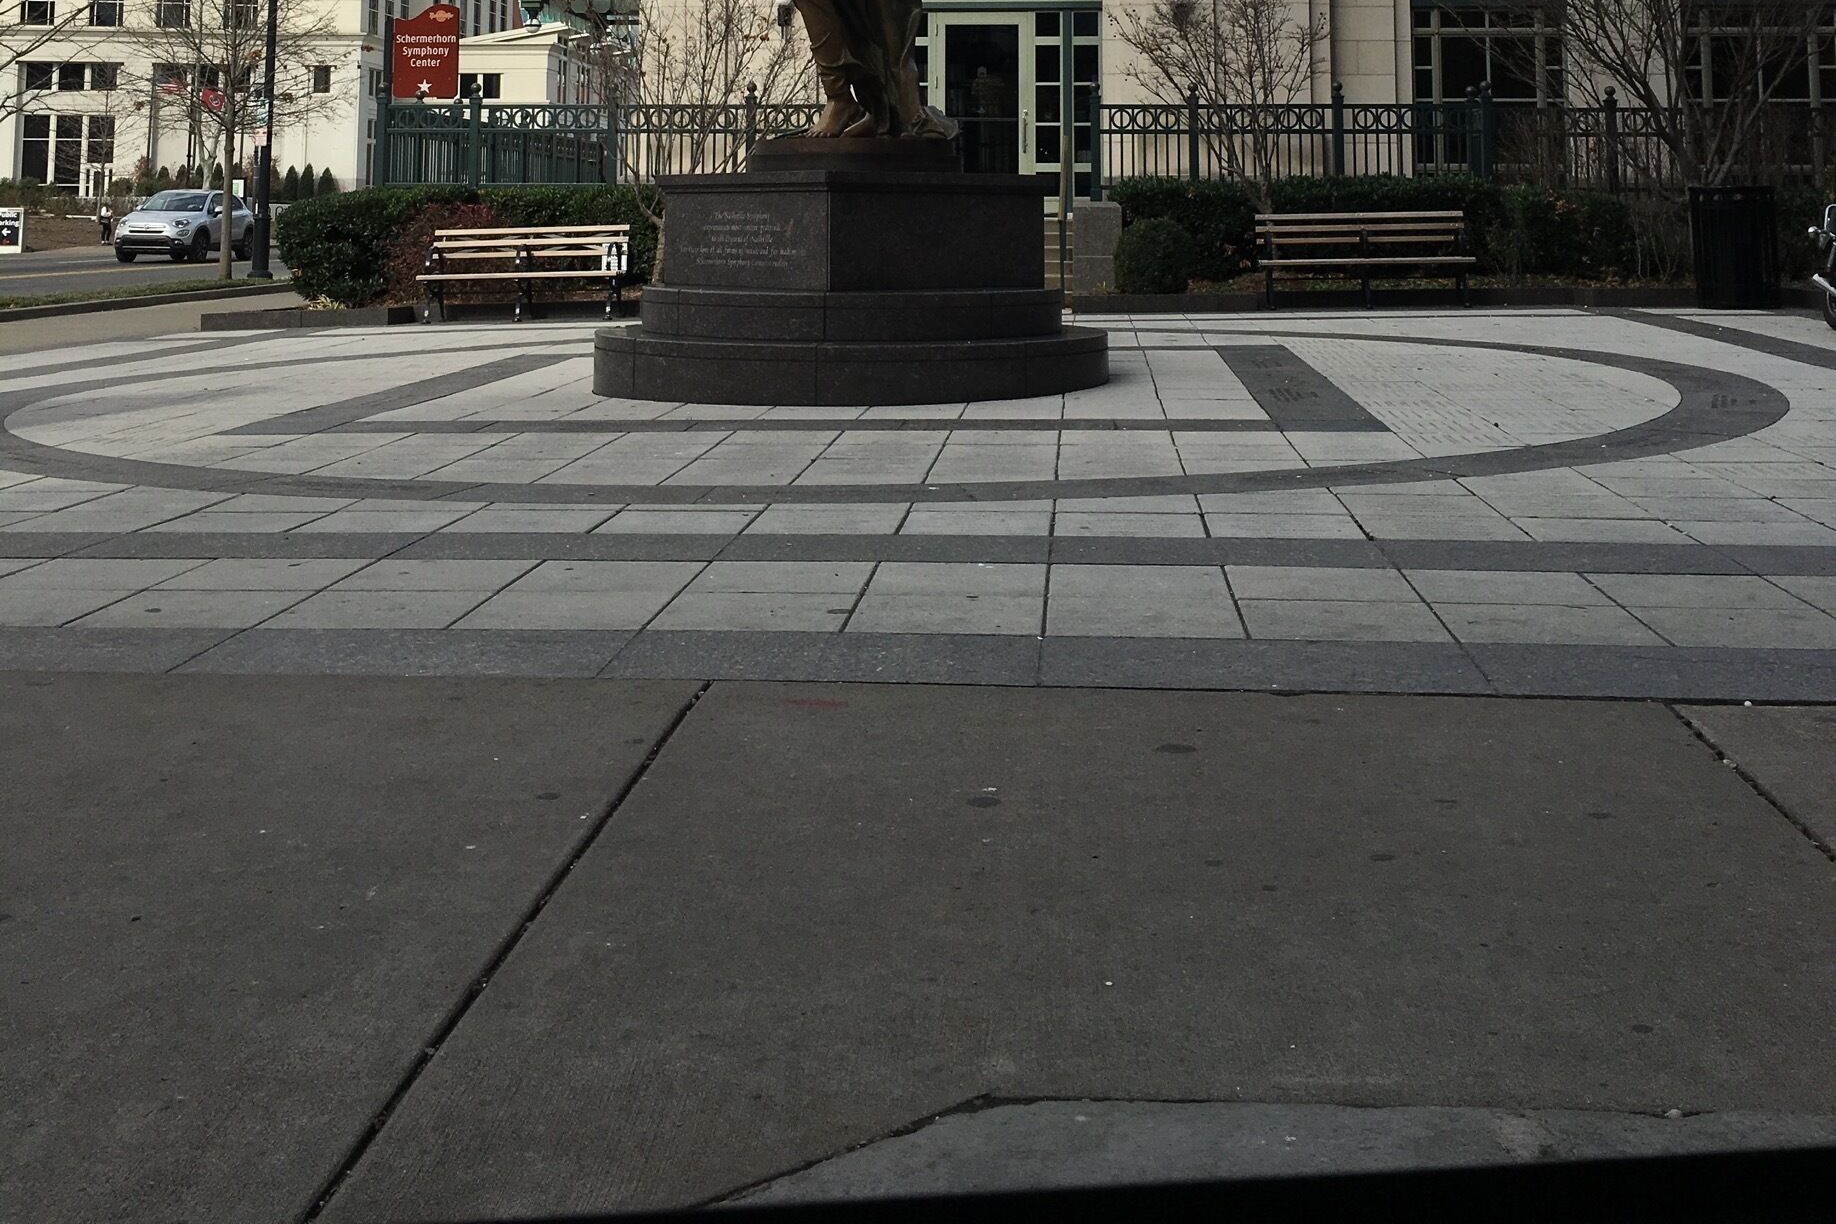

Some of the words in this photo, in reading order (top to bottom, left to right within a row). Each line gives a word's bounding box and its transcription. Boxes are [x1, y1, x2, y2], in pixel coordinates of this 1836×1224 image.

[396, 34, 457, 44] Schermerhorn
[402, 46, 449, 57] Symphony
[410, 58, 441, 67] Center
